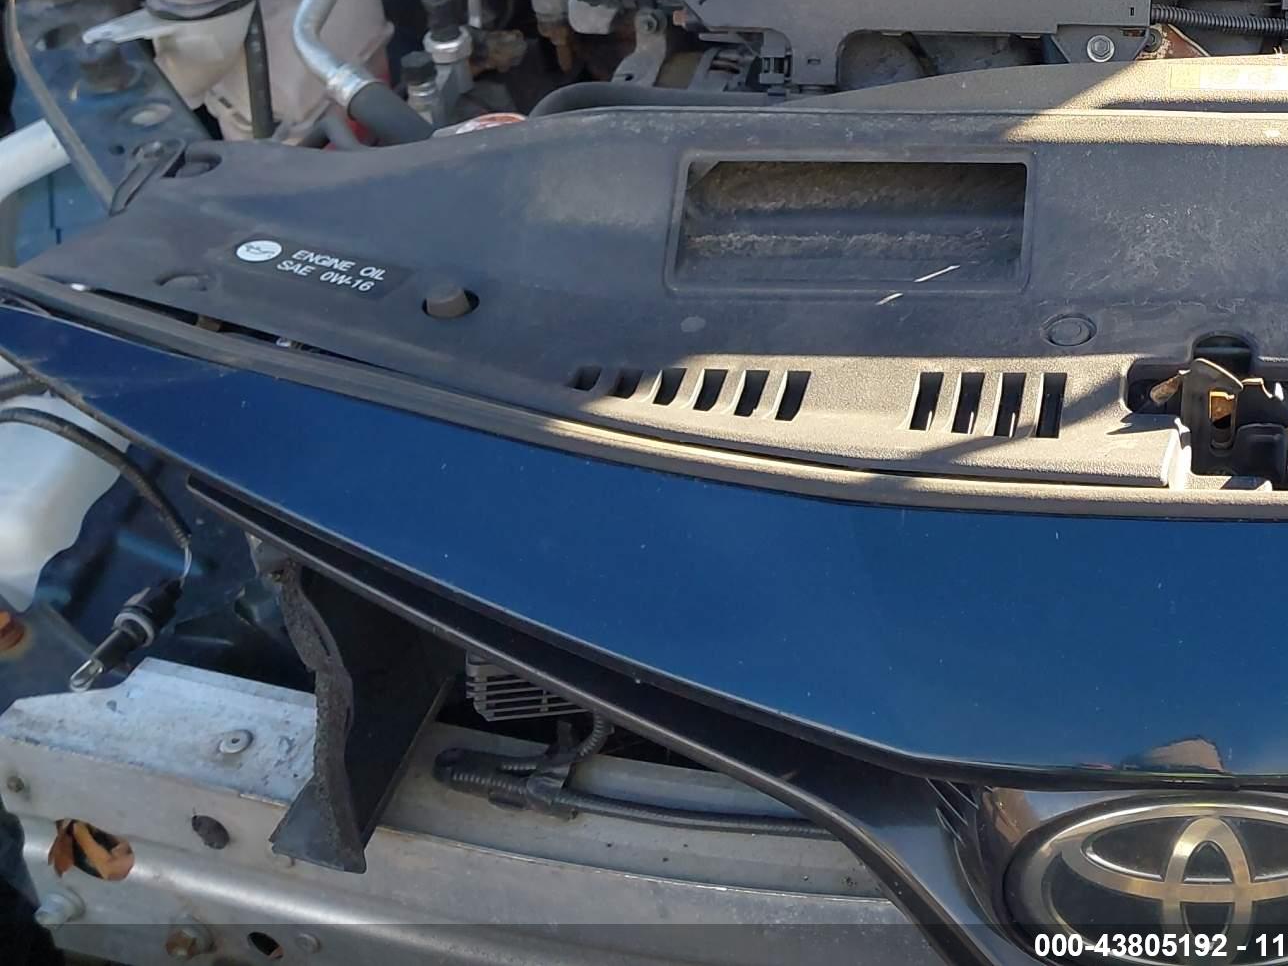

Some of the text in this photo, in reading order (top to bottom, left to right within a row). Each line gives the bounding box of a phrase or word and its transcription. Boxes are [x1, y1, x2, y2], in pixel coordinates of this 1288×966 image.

[276, 260, 375, 292] SAE 0W-16
[291, 249, 386, 281] ENGINE OIL
